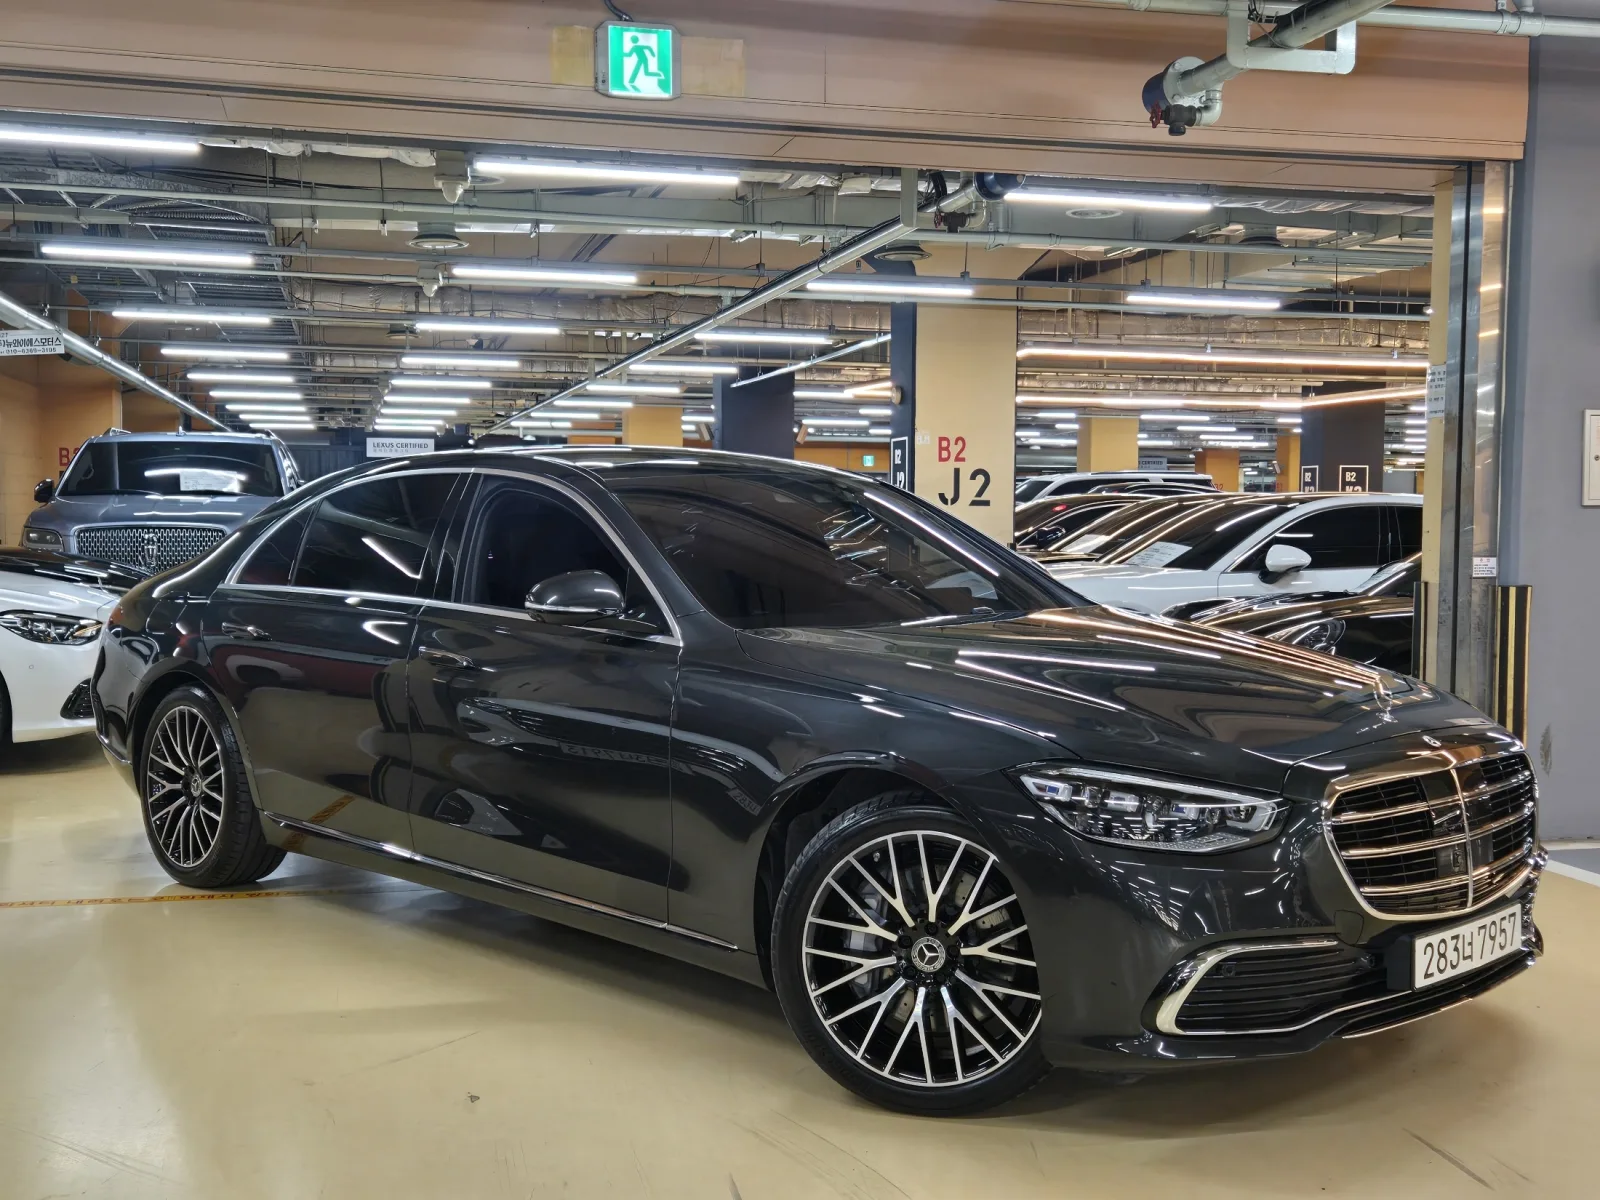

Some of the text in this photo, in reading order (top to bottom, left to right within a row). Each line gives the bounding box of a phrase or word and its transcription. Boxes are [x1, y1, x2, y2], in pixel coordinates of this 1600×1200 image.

[894, 449, 902, 465] B2
[938, 436, 966, 462] B2
[938, 467, 991, 507] J2
[1345, 471, 1357, 482] B2
[1423, 911, 1517, 980] 283너 7957
